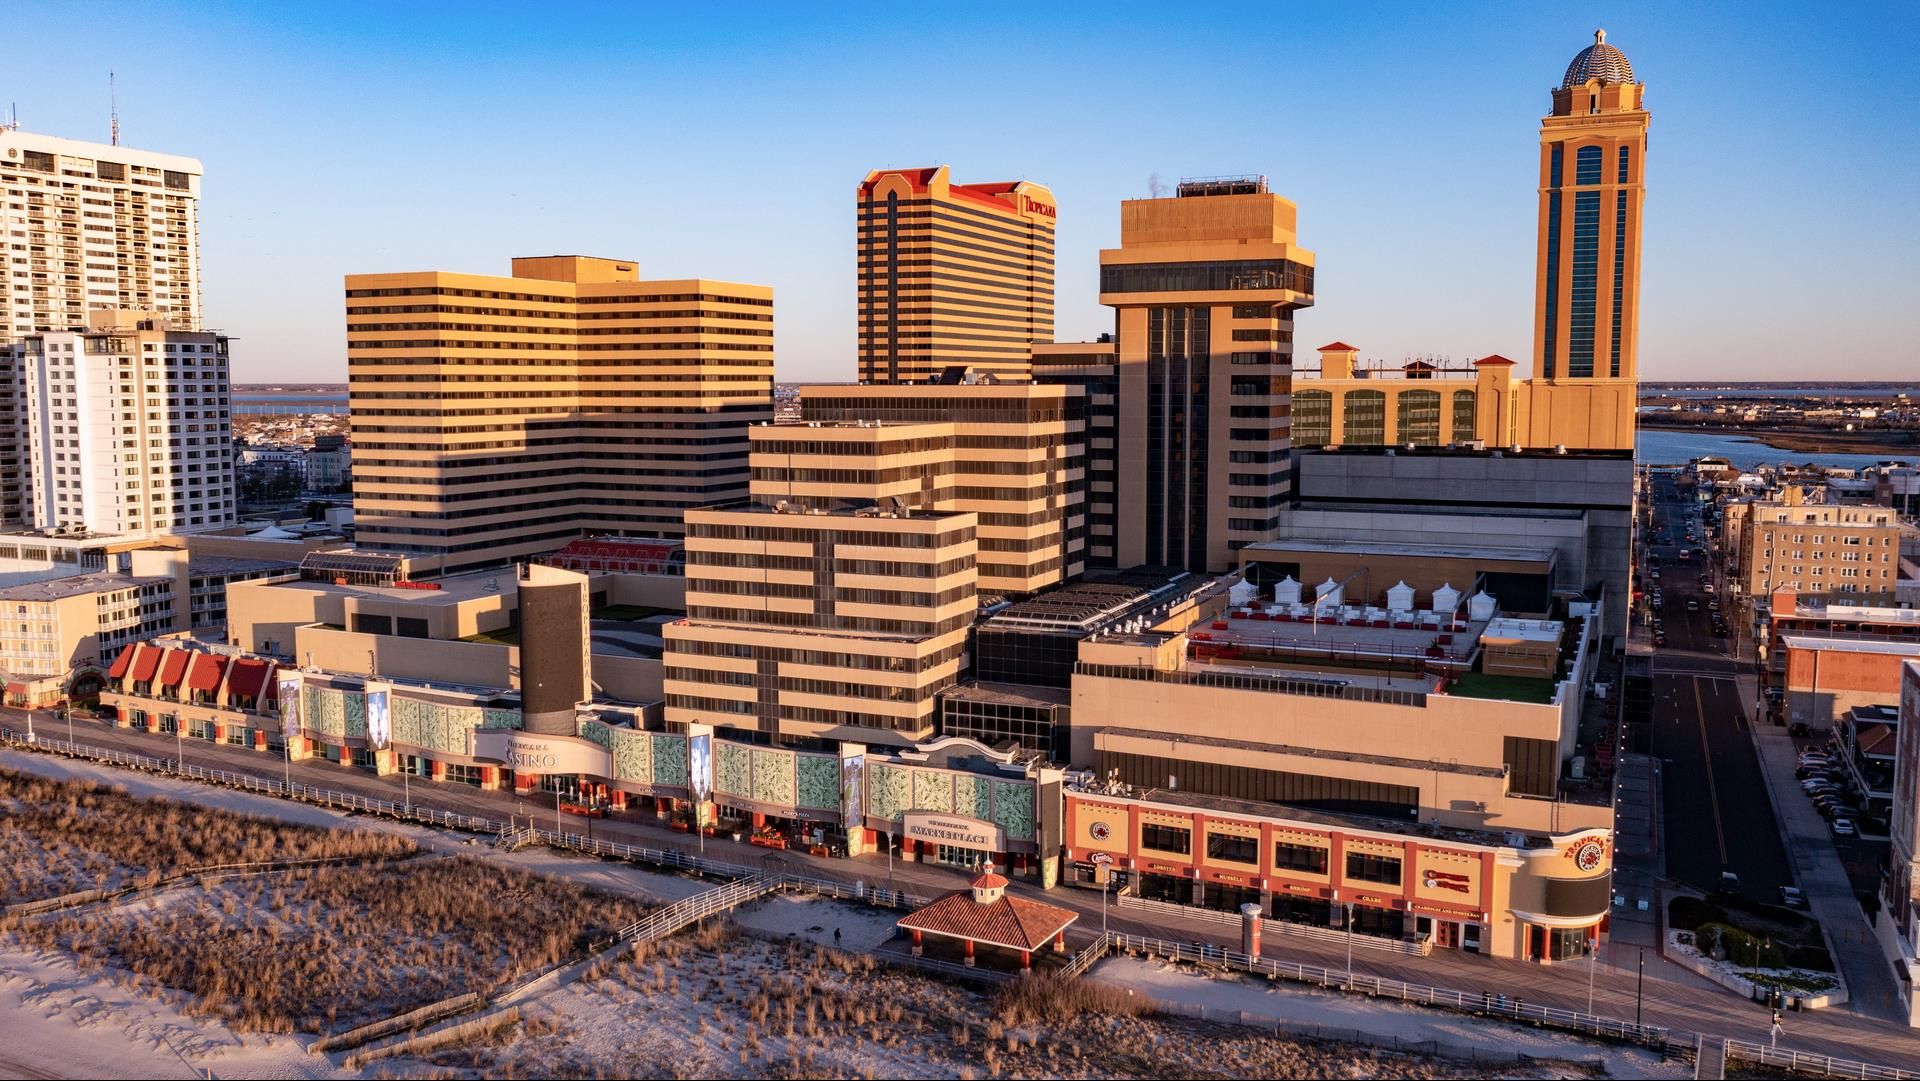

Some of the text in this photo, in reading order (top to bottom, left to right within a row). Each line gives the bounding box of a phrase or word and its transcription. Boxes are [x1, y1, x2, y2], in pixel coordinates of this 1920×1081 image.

[1023, 194, 1057, 219] TROPICANA
[583, 583, 591, 679] TROPICANA
[505, 747, 557, 768] CASINO
[911, 825, 989, 845] MARKETPLACE
[1563, 835, 1605, 859] TROPICANA
